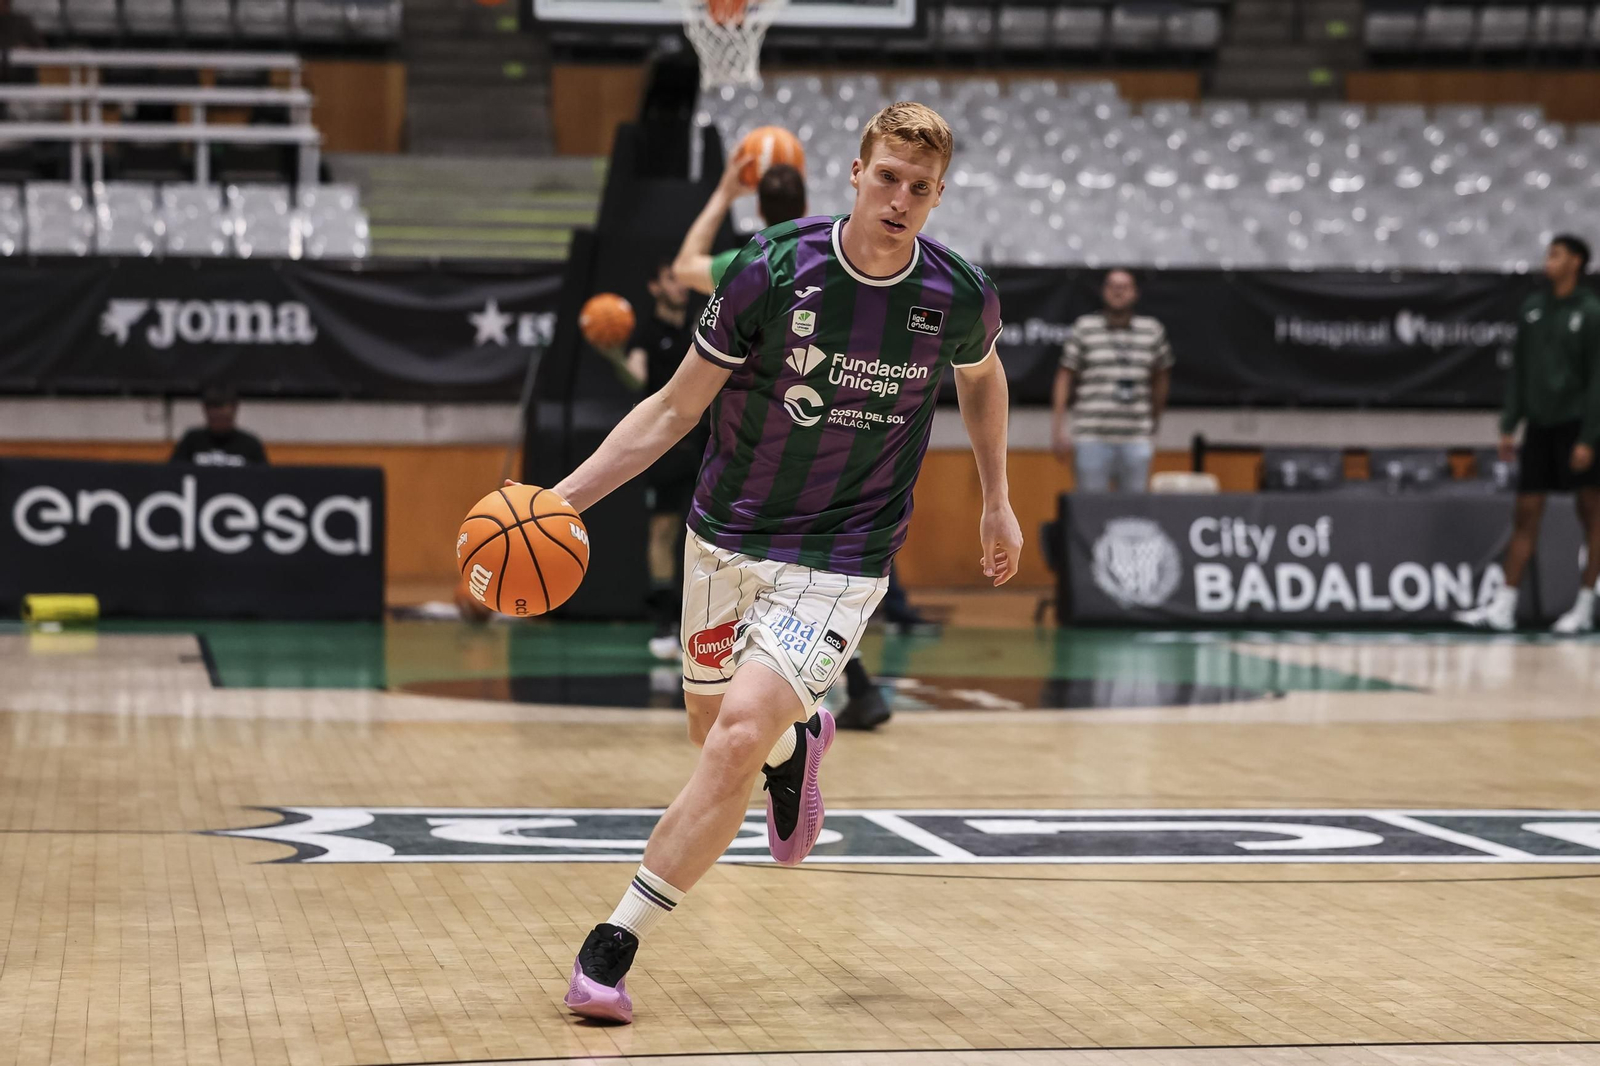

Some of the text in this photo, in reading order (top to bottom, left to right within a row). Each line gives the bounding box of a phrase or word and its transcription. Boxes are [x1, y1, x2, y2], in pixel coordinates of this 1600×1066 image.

[831, 353, 929, 380] Fundación
[828, 367, 899, 398] Unicaja
[827, 415, 871, 431] MÁLAGA
[830, 408, 906, 425] COSTA DEL SOL
[12, 474, 372, 556] endesa
[1188, 515, 1333, 565] City of
[1193, 561, 1507, 612] BADALONA
[826, 635, 841, 650] acb
